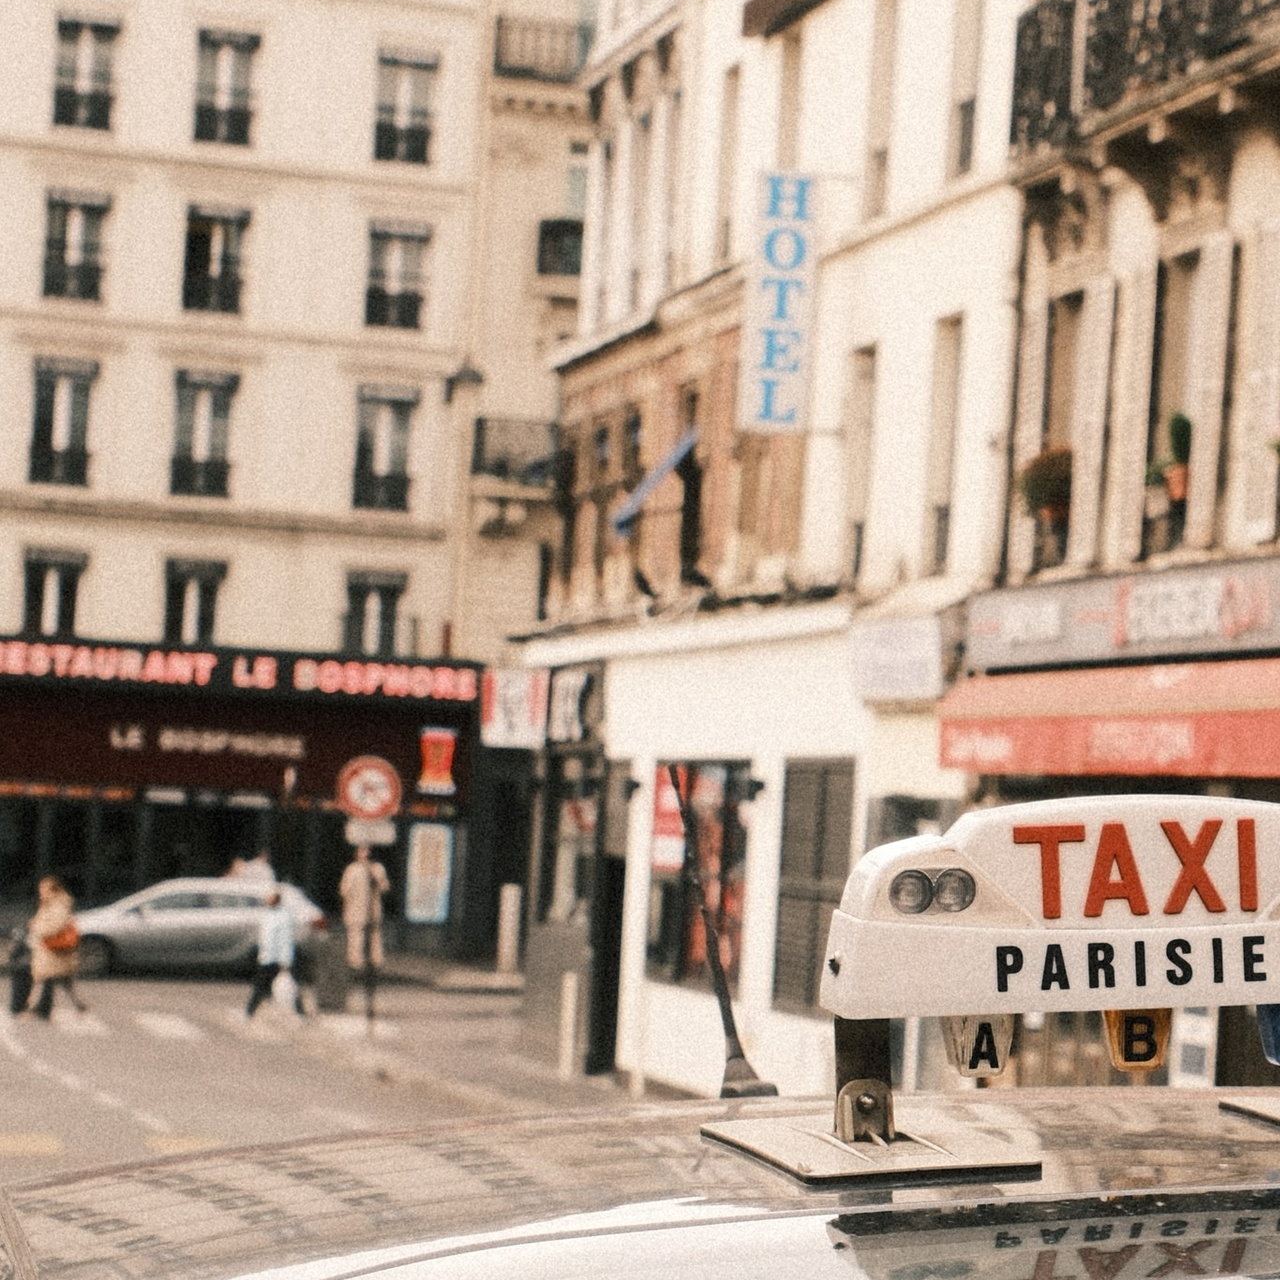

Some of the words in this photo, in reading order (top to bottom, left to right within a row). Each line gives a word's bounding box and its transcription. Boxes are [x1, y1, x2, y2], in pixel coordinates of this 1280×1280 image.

[755, 175, 813, 424] HOTEL
[0, 640, 218, 686] ESTAURANT
[232, 655, 278, 690] LE
[1012, 817, 1260, 920] TAXI
[968, 1022, 1000, 1071] A
[1122, 1015, 1158, 1063] B
